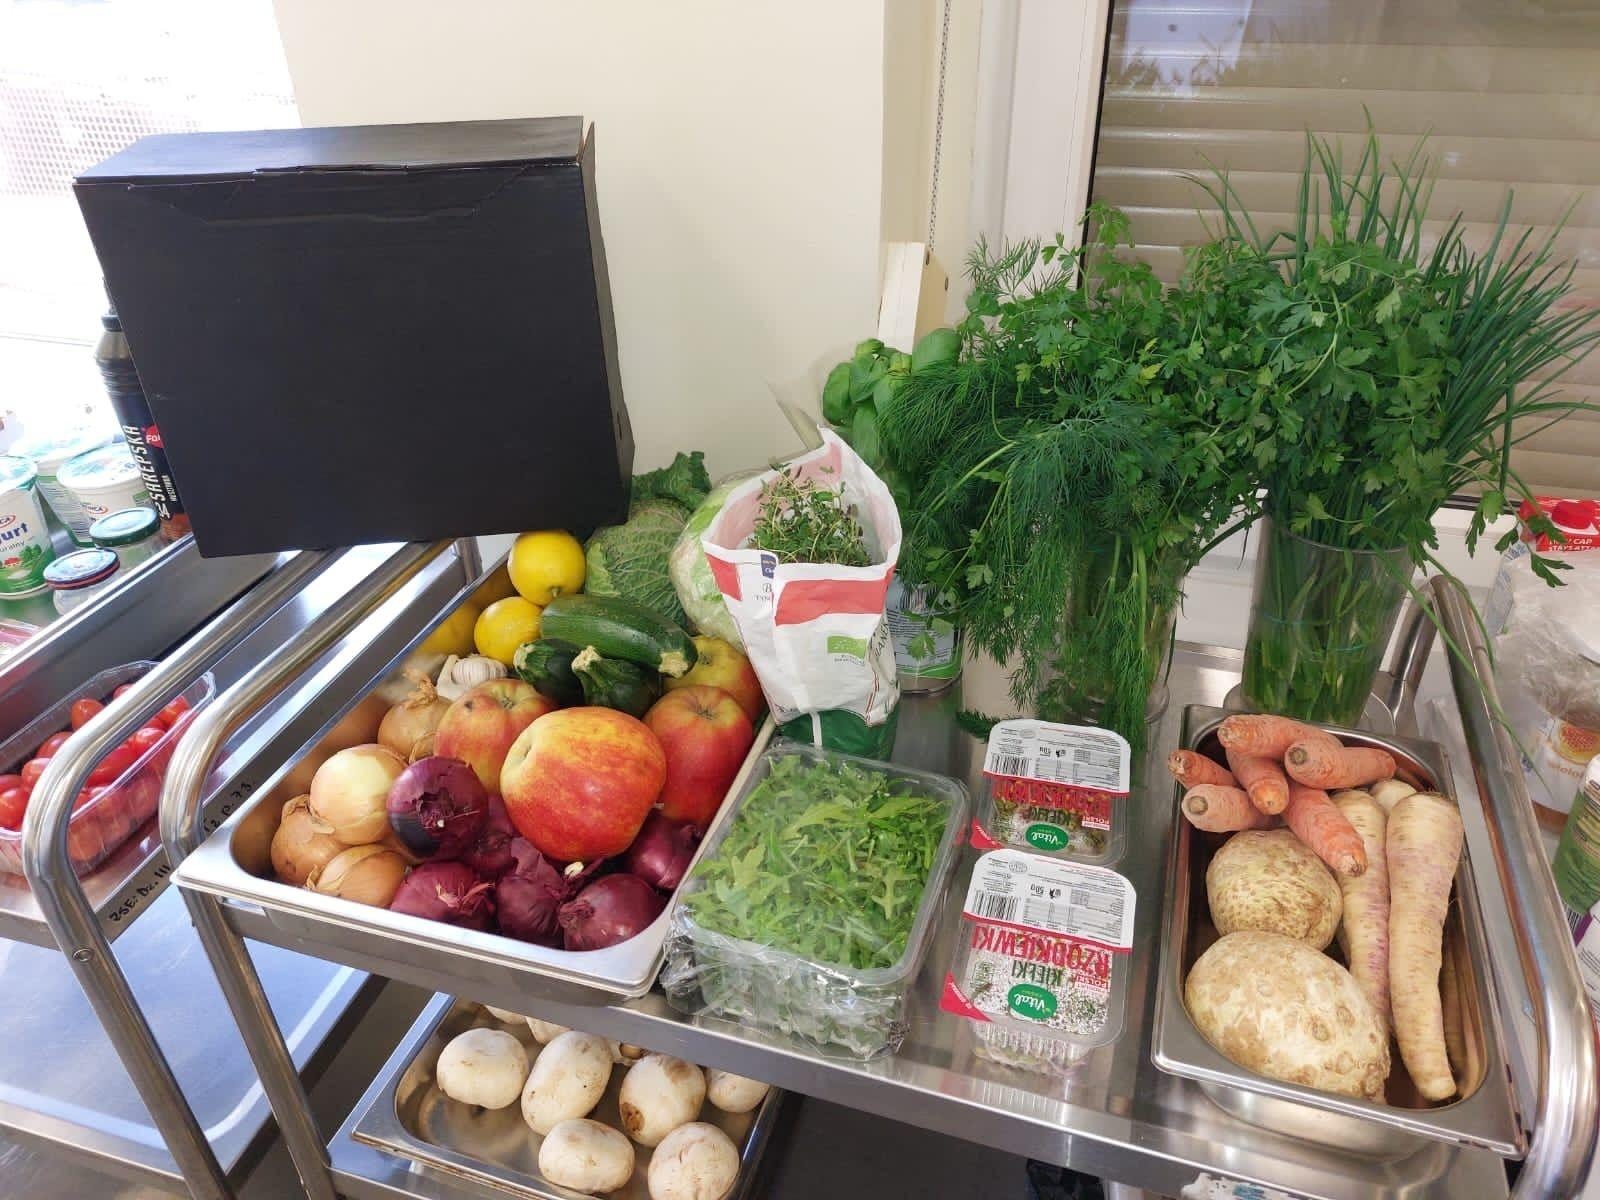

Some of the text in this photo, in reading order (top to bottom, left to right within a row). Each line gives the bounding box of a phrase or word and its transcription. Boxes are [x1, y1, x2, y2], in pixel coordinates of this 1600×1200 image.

[122, 425, 166, 501] SAREPSKA
[0, 522, 28, 543] urt
[1032, 830, 1060, 845] Vital
[1011, 959, 1063, 986] KIEŁKI
[1013, 993, 1046, 1010] Vital
